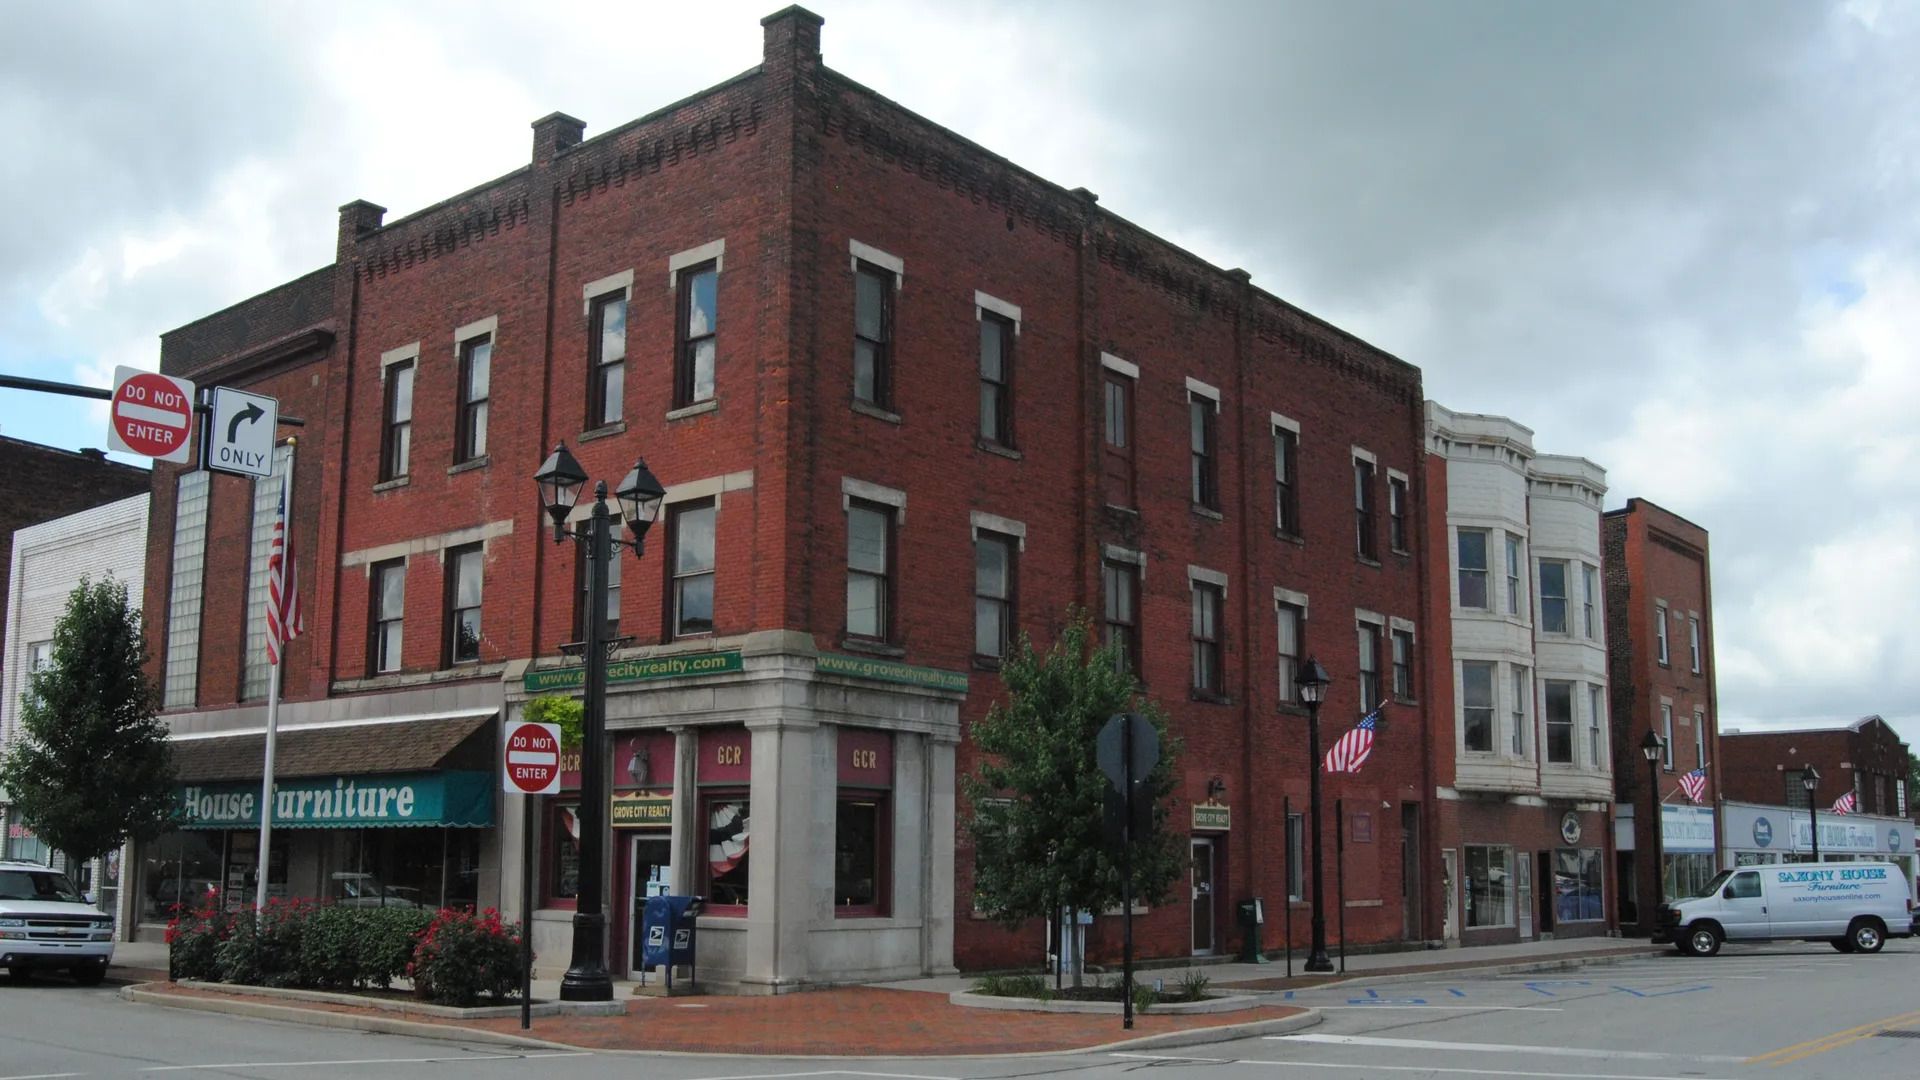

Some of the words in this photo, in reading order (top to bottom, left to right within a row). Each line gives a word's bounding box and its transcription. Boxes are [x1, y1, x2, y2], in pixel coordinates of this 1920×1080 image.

[125, 384, 146, 401] DO
[154, 390, 183, 408] NOT
[127, 423, 173, 445] ENTER
[220, 447, 265, 468] ONLY
[539, 655, 726, 685] www.gecityrealty.com
[817, 656, 968, 687] www.grovecityrealty.com
[513, 736, 527, 748] DO
[532, 737, 552, 749] NOT
[561, 754, 580, 772] GCR
[717, 746, 741, 766] GCR
[853, 750, 876, 769] GCR
[516, 767, 548, 779] ENTER
[184, 786, 254, 821] House
[270, 777, 415, 819] urniture
[613, 806, 633, 818] GROVE
[634, 805, 648, 818] CITY
[648, 804, 671, 817] REALTY
[1778, 870, 1834, 882] SAXONY
[1839, 868, 1886, 880] HOUSE
[1808, 881, 1860, 891] Furniture
[1793, 893, 1880, 902] saxonyhouseonline.com
